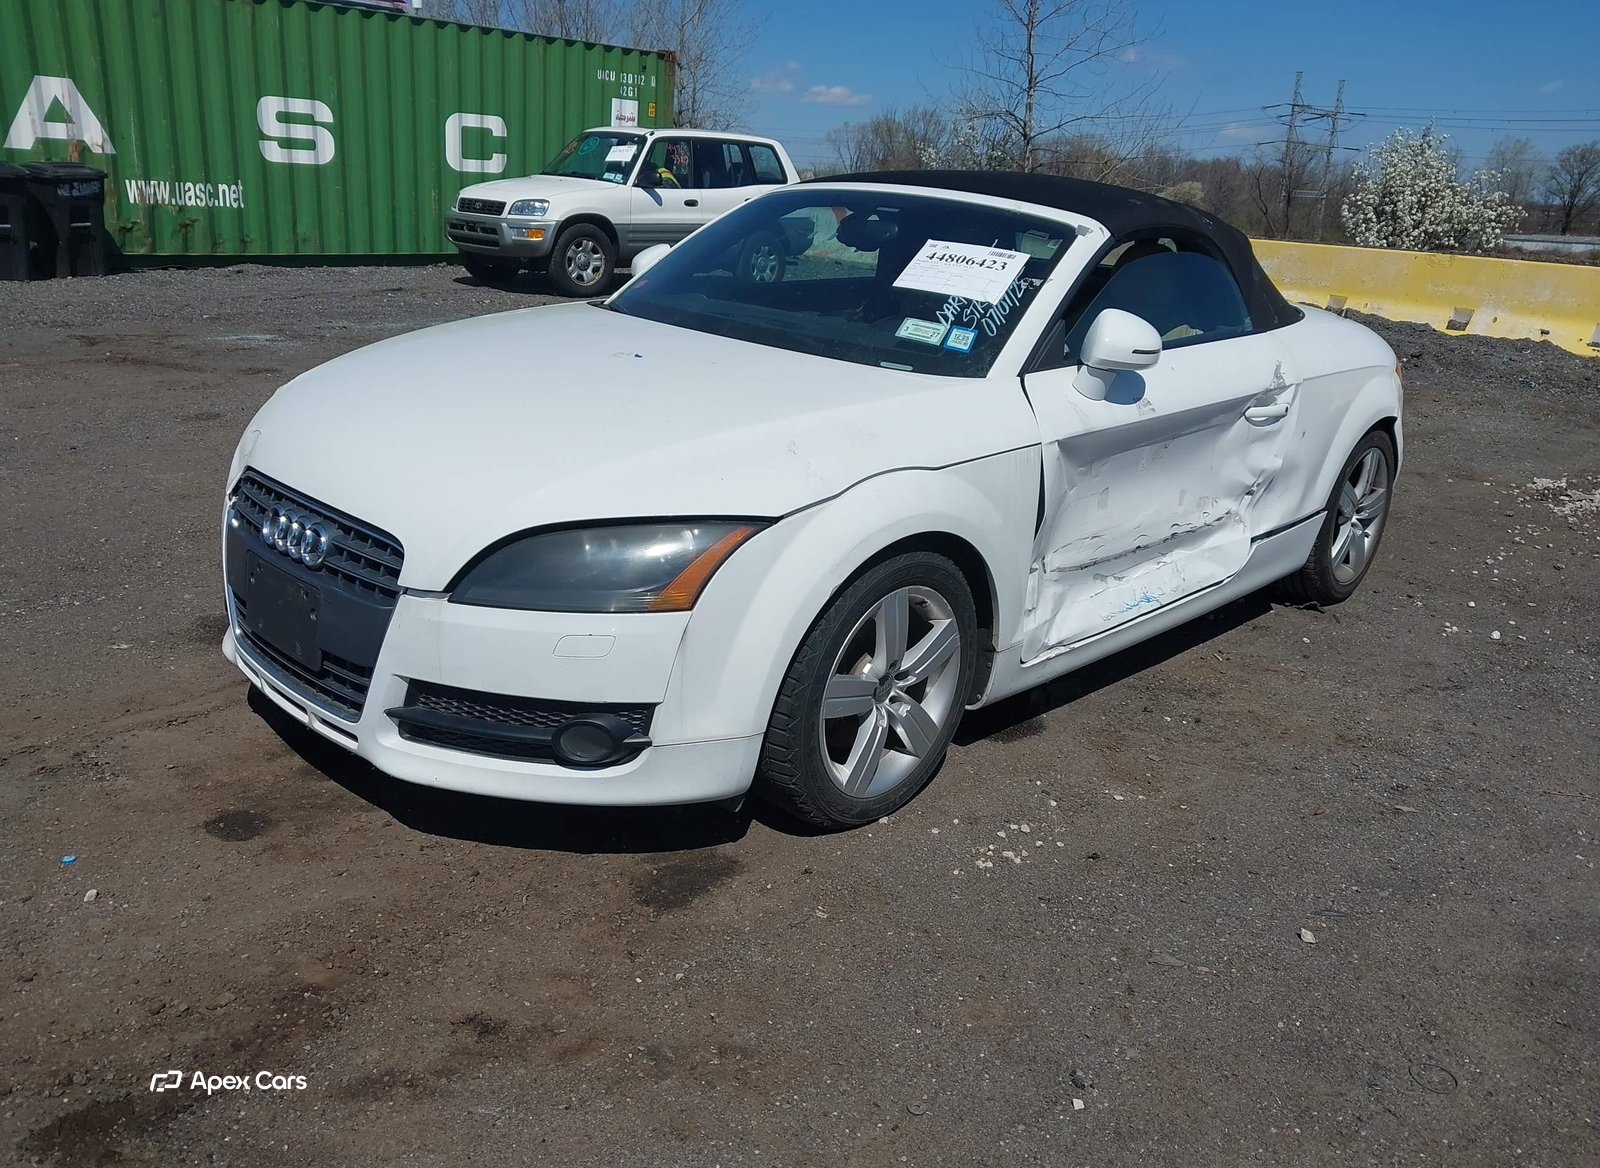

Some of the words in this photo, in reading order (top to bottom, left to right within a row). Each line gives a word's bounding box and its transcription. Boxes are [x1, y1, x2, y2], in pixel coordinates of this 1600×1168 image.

[4, 75, 116, 154] A
[257, 95, 334, 165] S
[445, 112, 507, 173] C
[125, 179, 245, 208] www.uasc.net
[926, 251, 1008, 271] 44806423
